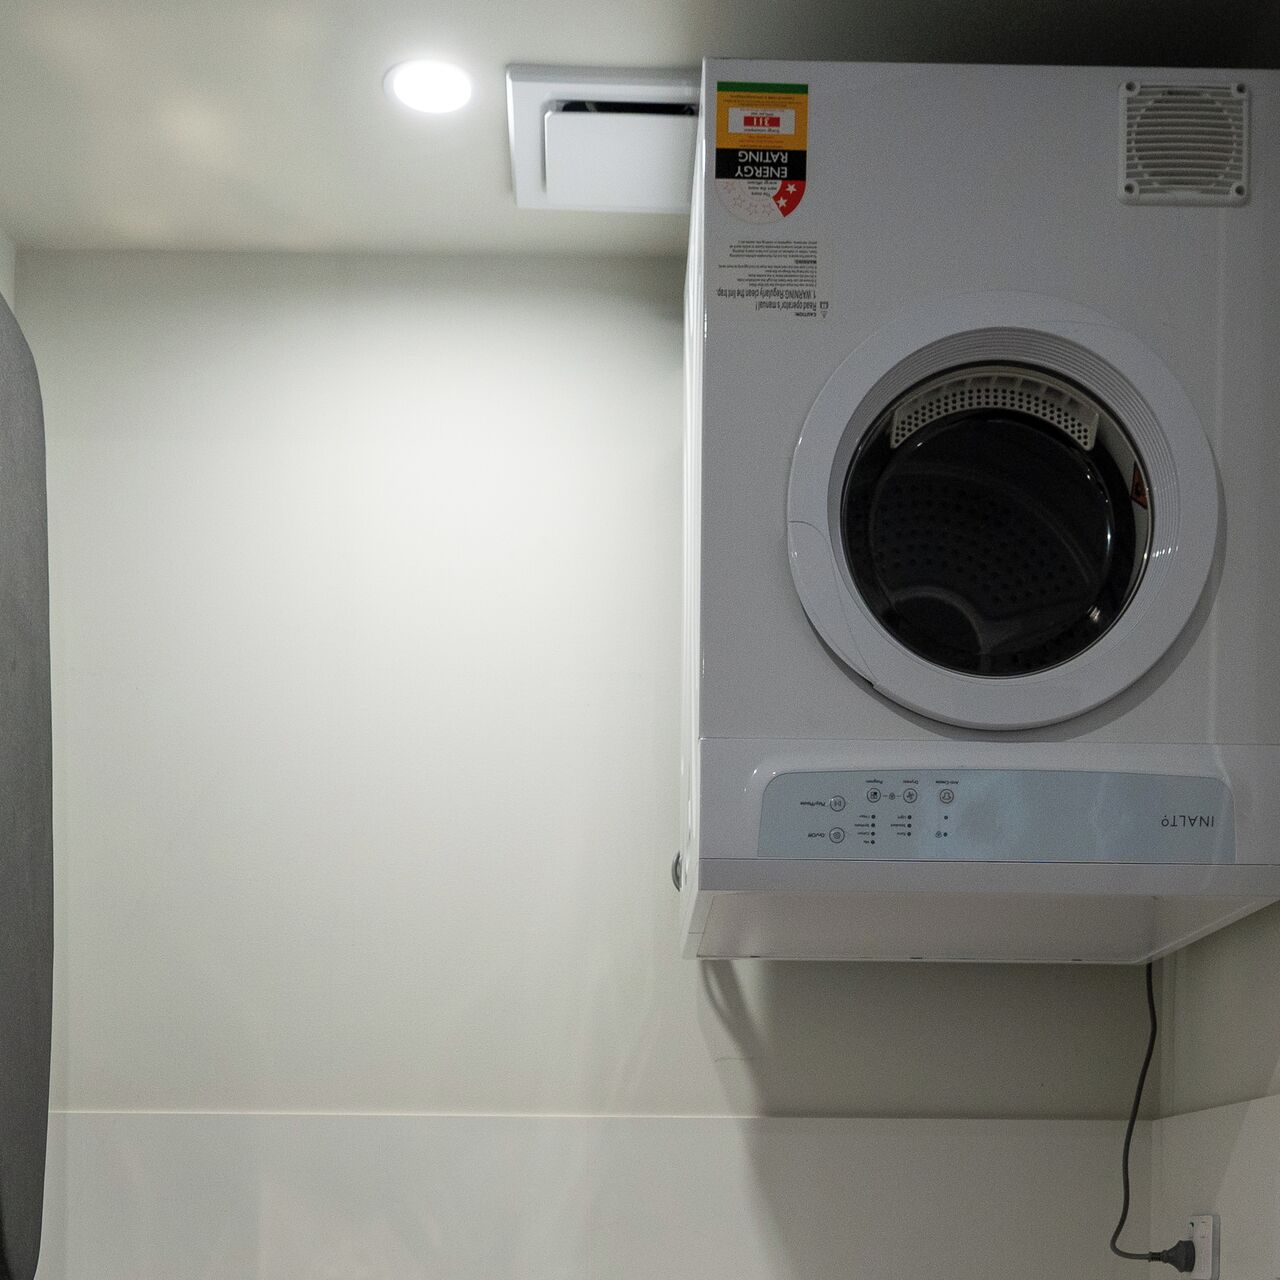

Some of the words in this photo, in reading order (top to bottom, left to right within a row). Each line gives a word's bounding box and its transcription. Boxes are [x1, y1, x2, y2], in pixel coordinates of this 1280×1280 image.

[753, 117, 770, 126] 311
[738, 150, 788, 163] RATING
[734, 165, 788, 178] ENERGY
[736, 289, 745, 299] the
[745, 289, 759, 299] clean
[804, 301, 817, 312] Read
